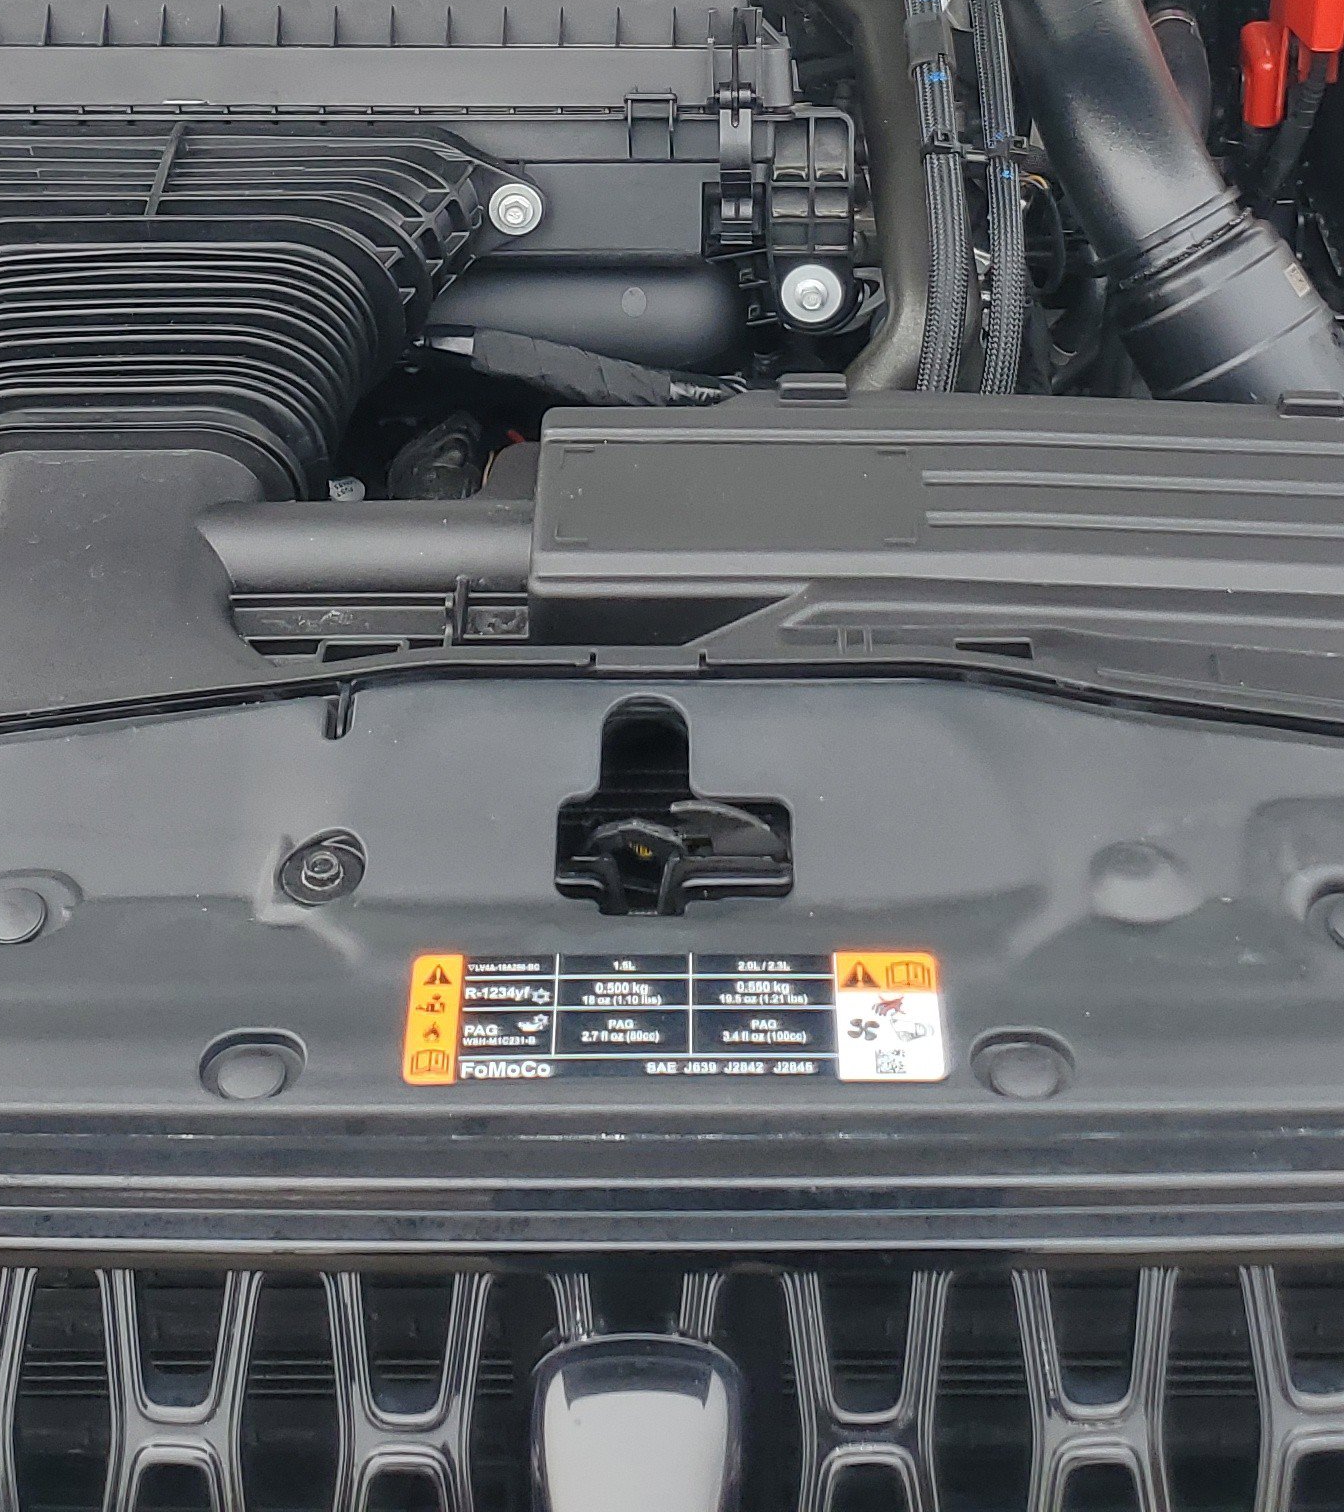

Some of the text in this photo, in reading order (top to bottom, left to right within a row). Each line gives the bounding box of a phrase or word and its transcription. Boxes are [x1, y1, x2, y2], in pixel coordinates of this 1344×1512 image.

[738, 961, 760, 972] 2.0L
[464, 986, 531, 1001] R-1234yf
[595, 982, 649, 996] 0.500 kg
[772, 981, 790, 995] kg
[582, 995, 662, 1006] 18 oz (1.10 lbs)
[743, 996, 757, 1004] oz
[787, 994, 808, 1005] lbs)
[608, 1019, 635, 1030] PAG
[751, 1019, 777, 1030] PAG
[464, 1025, 498, 1037] PAG
[581, 1031, 599, 1042] 2.7
[601, 1031, 609, 1042] fl
[611, 1033, 625, 1042] oz
[722, 1030, 807, 1044] 3.4 fl oz (100cc)
[460, 1061, 551, 1078] FoMoCo
[646, 1062, 677, 1073] SAE
